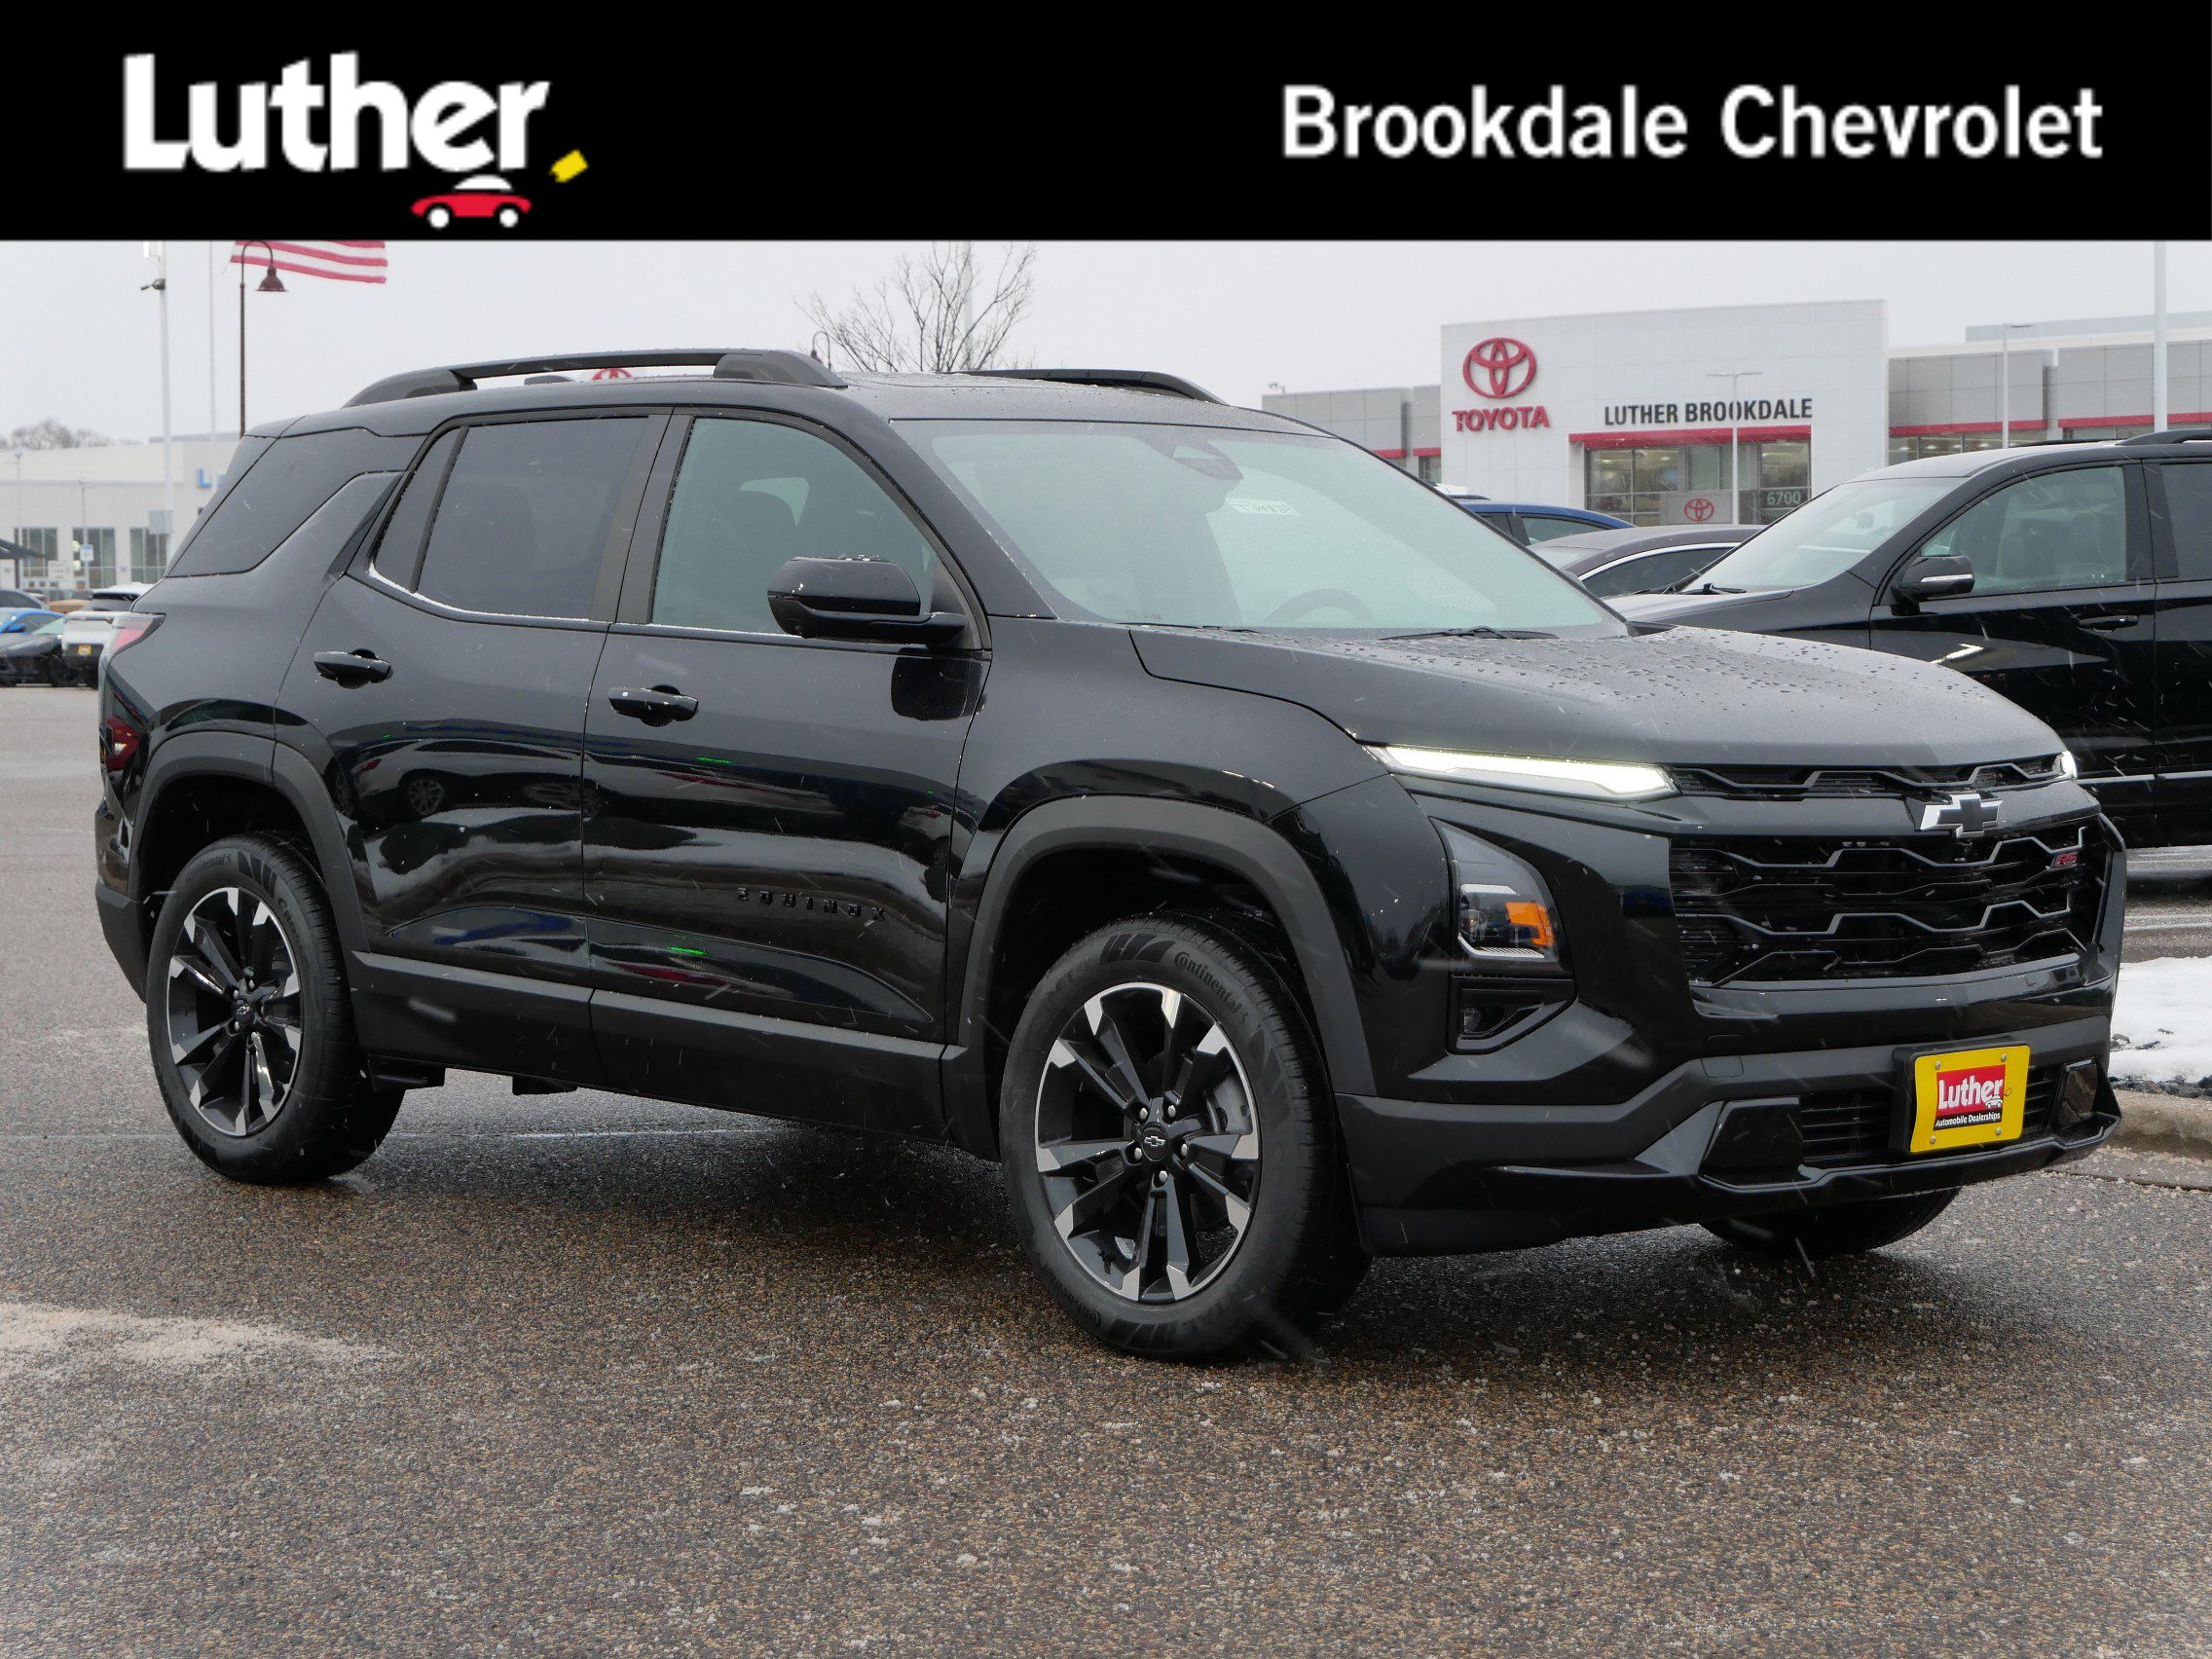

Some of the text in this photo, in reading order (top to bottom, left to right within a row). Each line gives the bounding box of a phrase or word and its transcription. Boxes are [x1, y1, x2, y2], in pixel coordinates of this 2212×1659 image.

[1452, 405, 1550, 432] TOYOTA
[1604, 398, 1813, 425] LUTHER BROOKDALE
[1766, 491, 1801, 505] 6700
[737, 887, 885, 921] EQUINOX
[1174, 950, 1243, 1014] Continental
[1937, 1075, 2005, 1110] Luther
[1935, 1111, 2001, 1127] Automobile Dealerships
